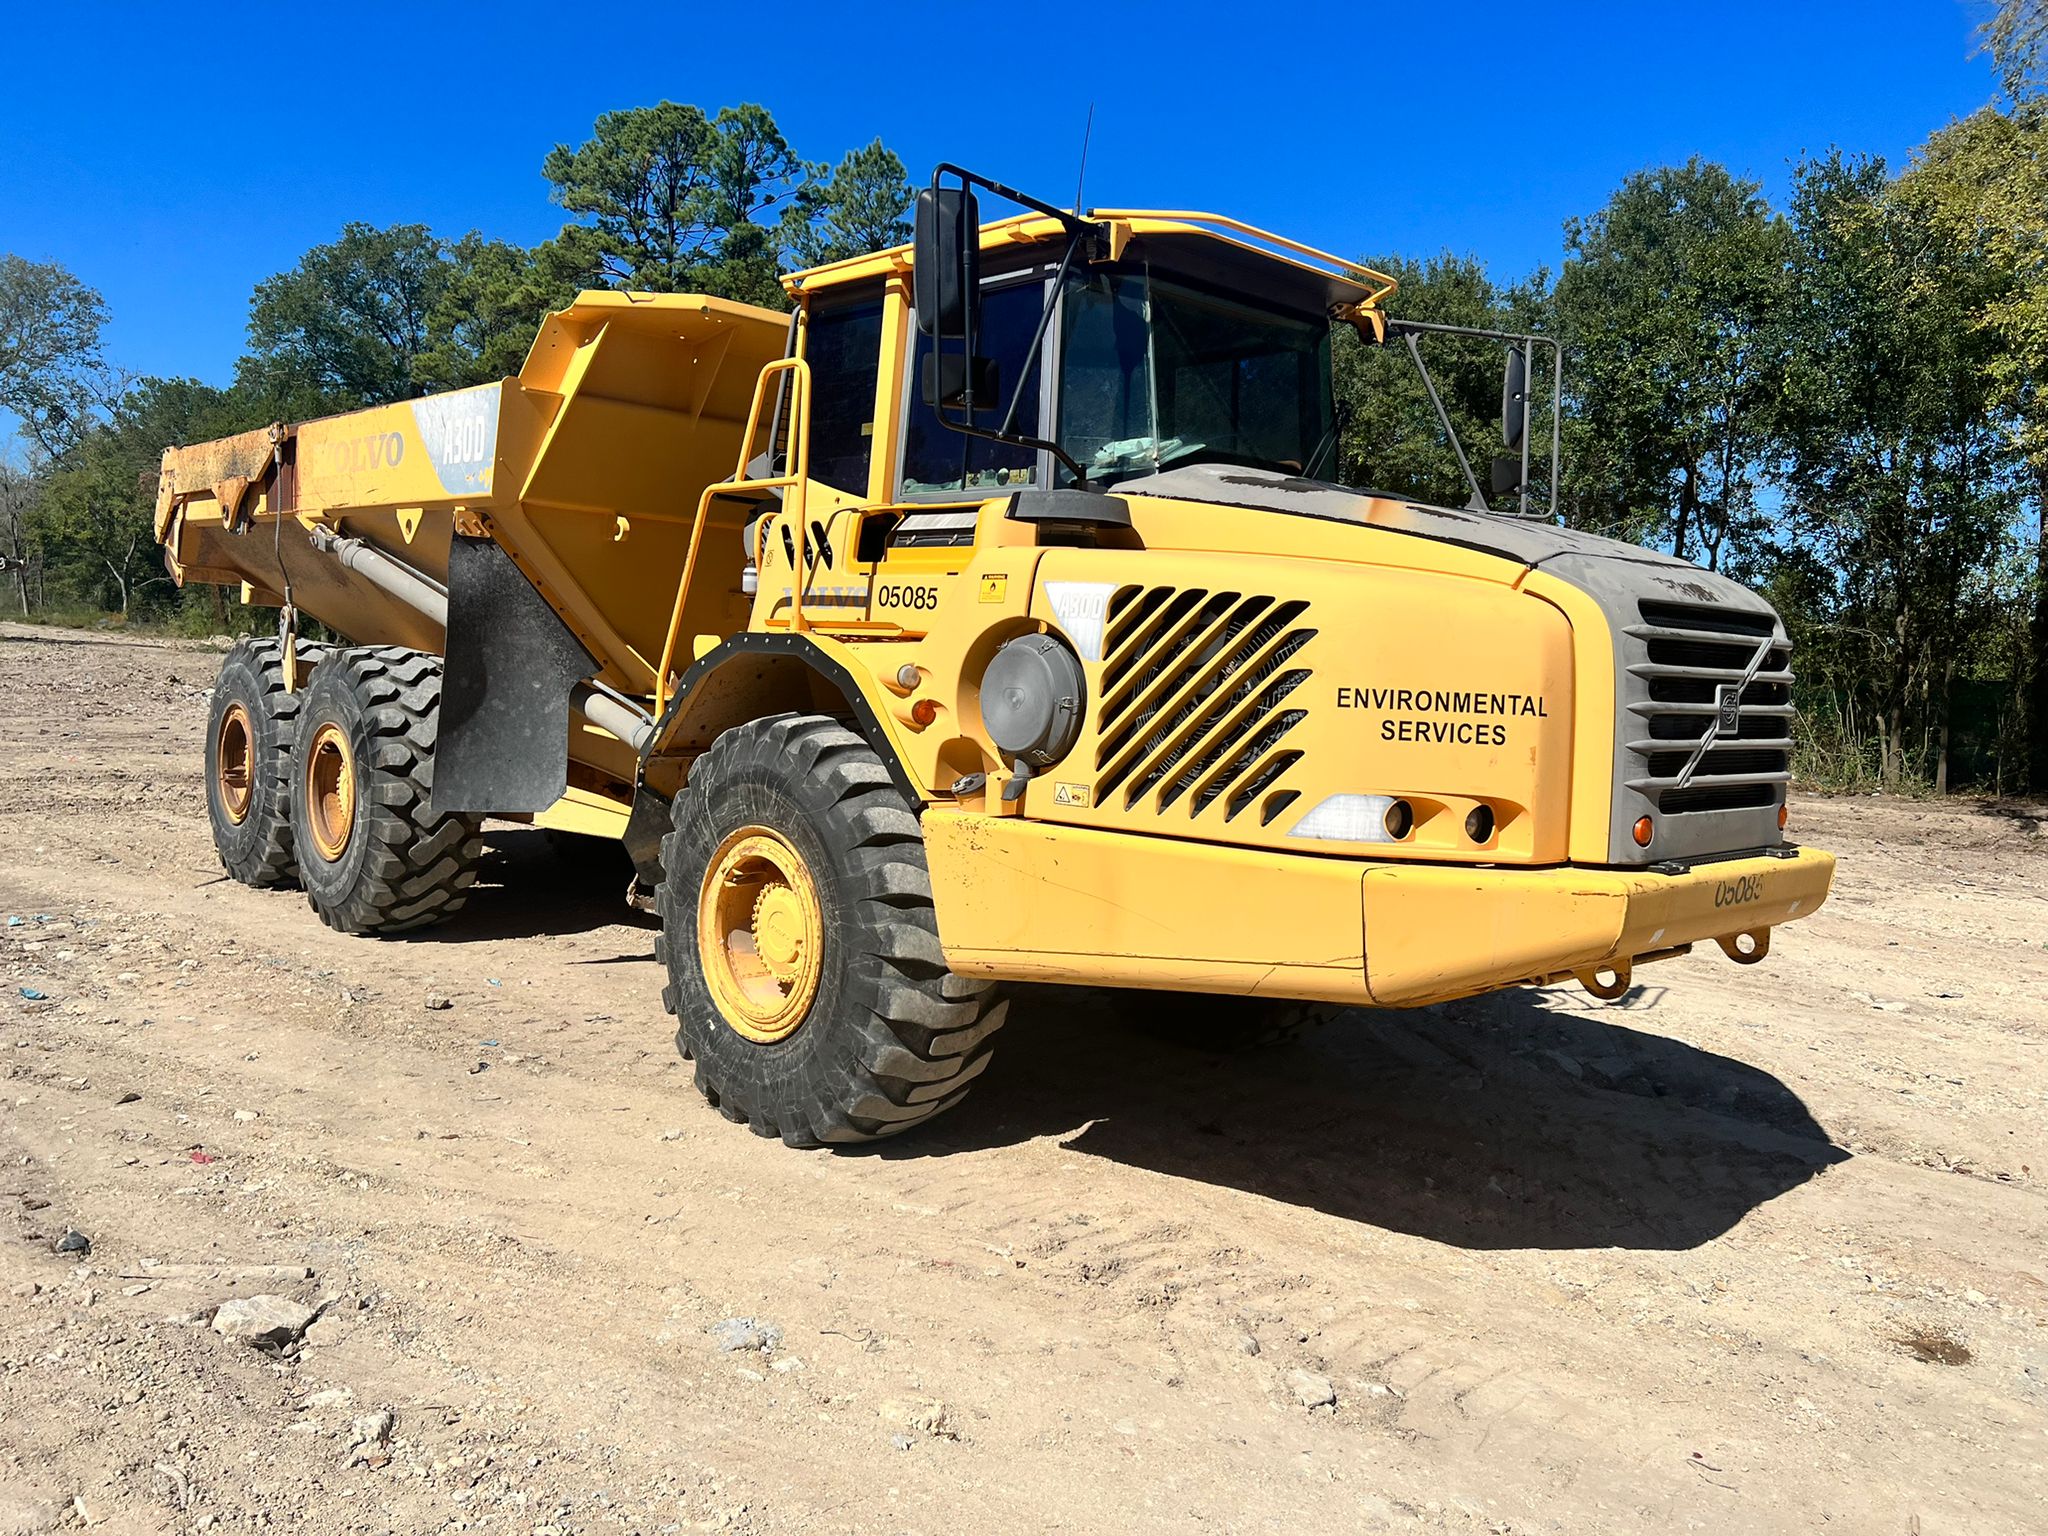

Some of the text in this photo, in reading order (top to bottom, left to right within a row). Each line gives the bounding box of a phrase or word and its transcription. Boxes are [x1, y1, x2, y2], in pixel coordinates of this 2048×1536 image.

[321, 431, 405, 473] OLVO
[443, 416, 485, 465] A30D
[878, 585, 938, 610] 05085
[1337, 687, 1548, 718] ENVIRONMENTAL
[1380, 719, 1506, 746] SERVICES
